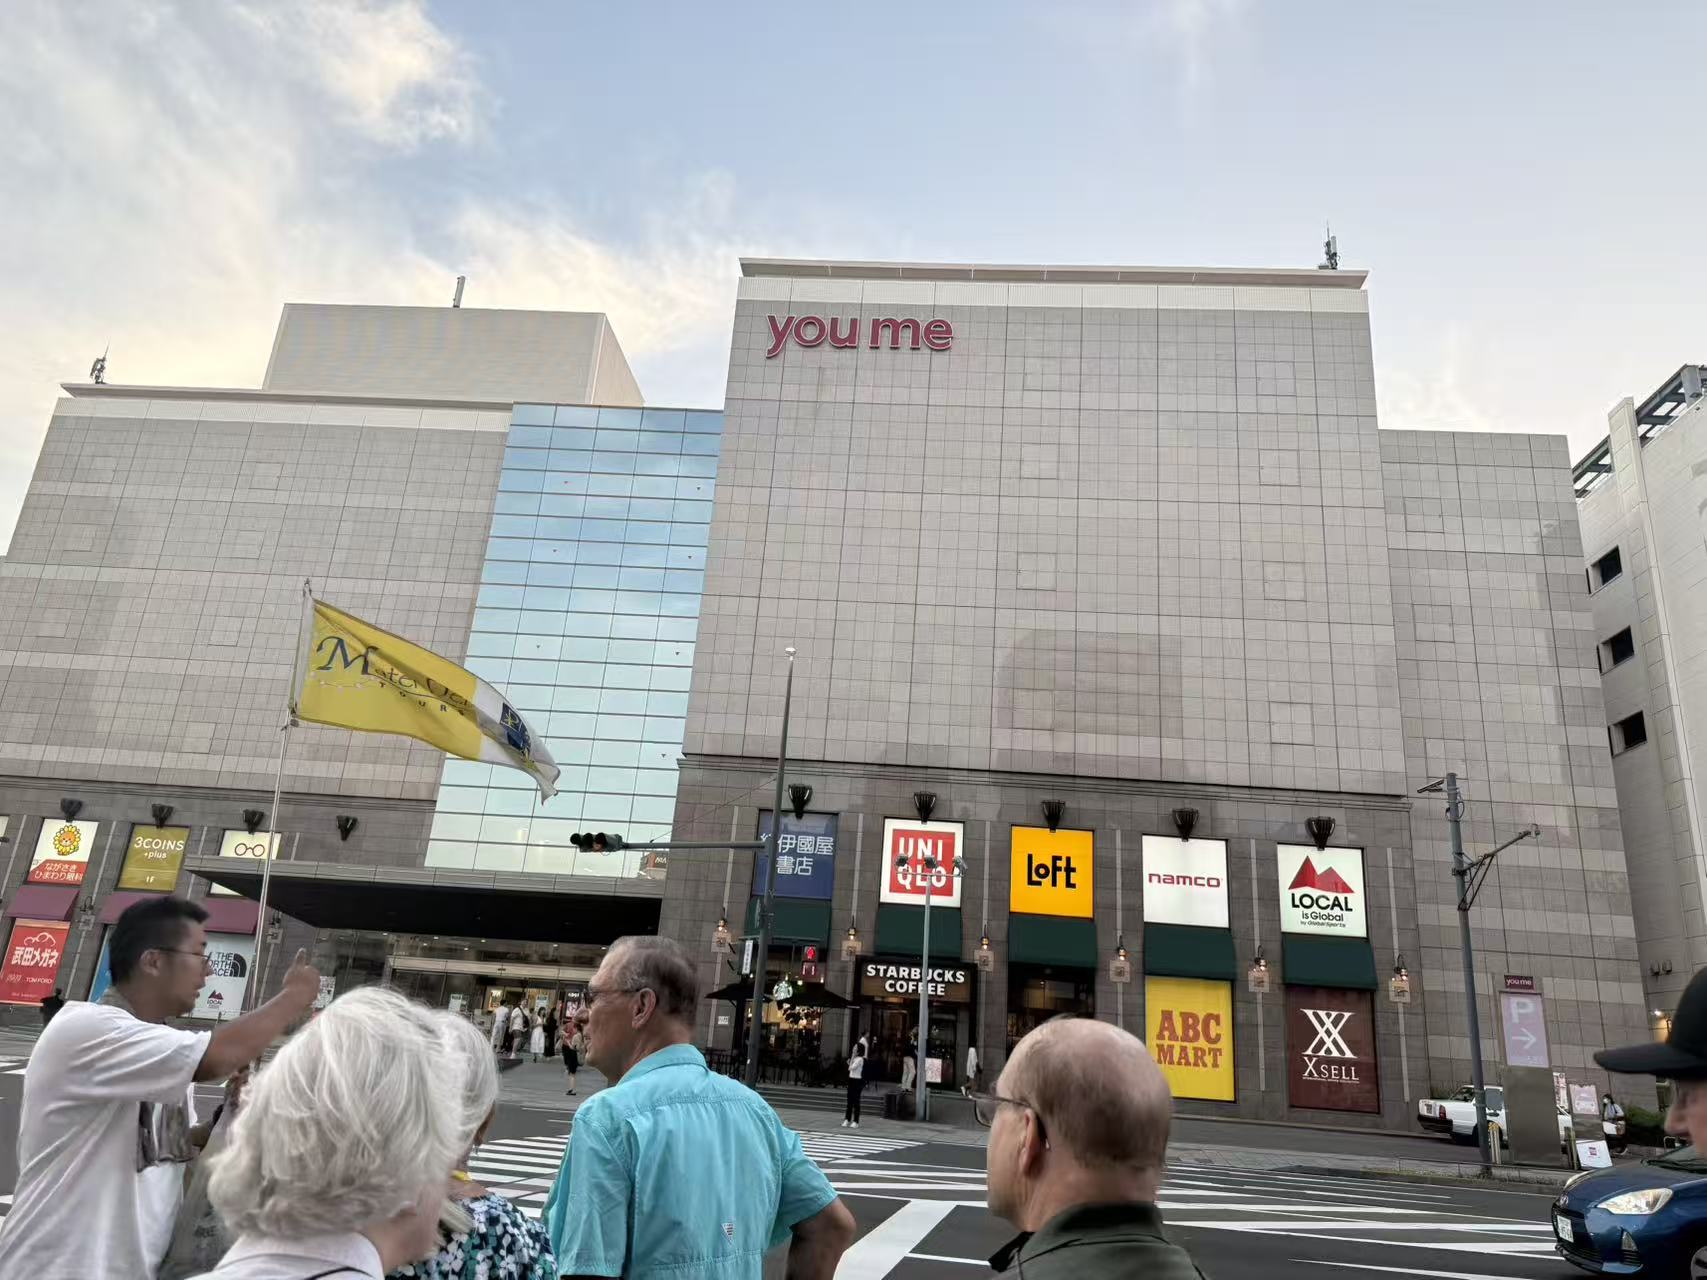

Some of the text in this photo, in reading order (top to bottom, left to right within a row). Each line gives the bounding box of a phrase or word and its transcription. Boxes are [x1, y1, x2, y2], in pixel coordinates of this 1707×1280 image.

[766, 314, 953, 359] you me
[134, 836, 185, 851] 3COINS
[760, 833, 835, 856] 伊國屋
[898, 837, 943, 861] UNI
[44, 863, 78, 873] ながさき
[776, 855, 814, 876] 書店
[897, 864, 947, 890] QLO
[1148, 873, 1221, 888] namco
[1291, 893, 1353, 912] LOCAL
[1302, 911, 1344, 922] is Global
[11, 946, 60, 968] 武田メガネ
[208, 960, 232, 969] ORTH
[216, 952, 233, 961] THE
[214, 968, 230, 977] ACE
[884, 980, 946, 996] COFFEE
[1510, 997, 1535, 1024] P
[1156, 1010, 1222, 1044] ABC
[1156, 1044, 1222, 1068] MART
